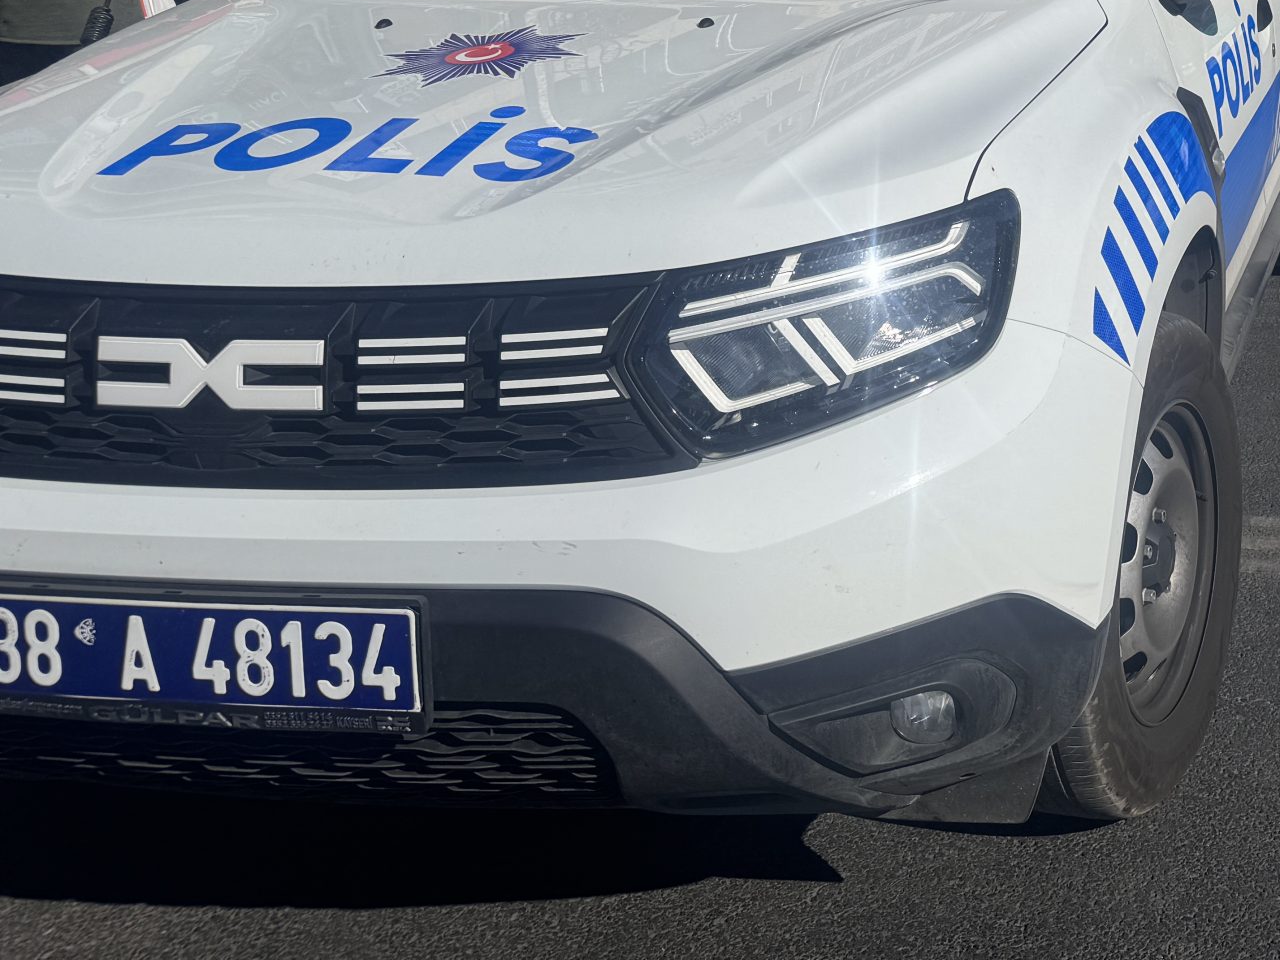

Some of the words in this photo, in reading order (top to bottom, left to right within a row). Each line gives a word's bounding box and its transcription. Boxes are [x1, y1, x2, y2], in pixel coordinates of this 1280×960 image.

[95, 105, 600, 183] POLİS
[121, 615, 161, 693] A
[193, 617, 401, 701] 48134
[89, 703, 261, 729] GÜLPAR
[336, 715, 373, 729] KAYSERİ
